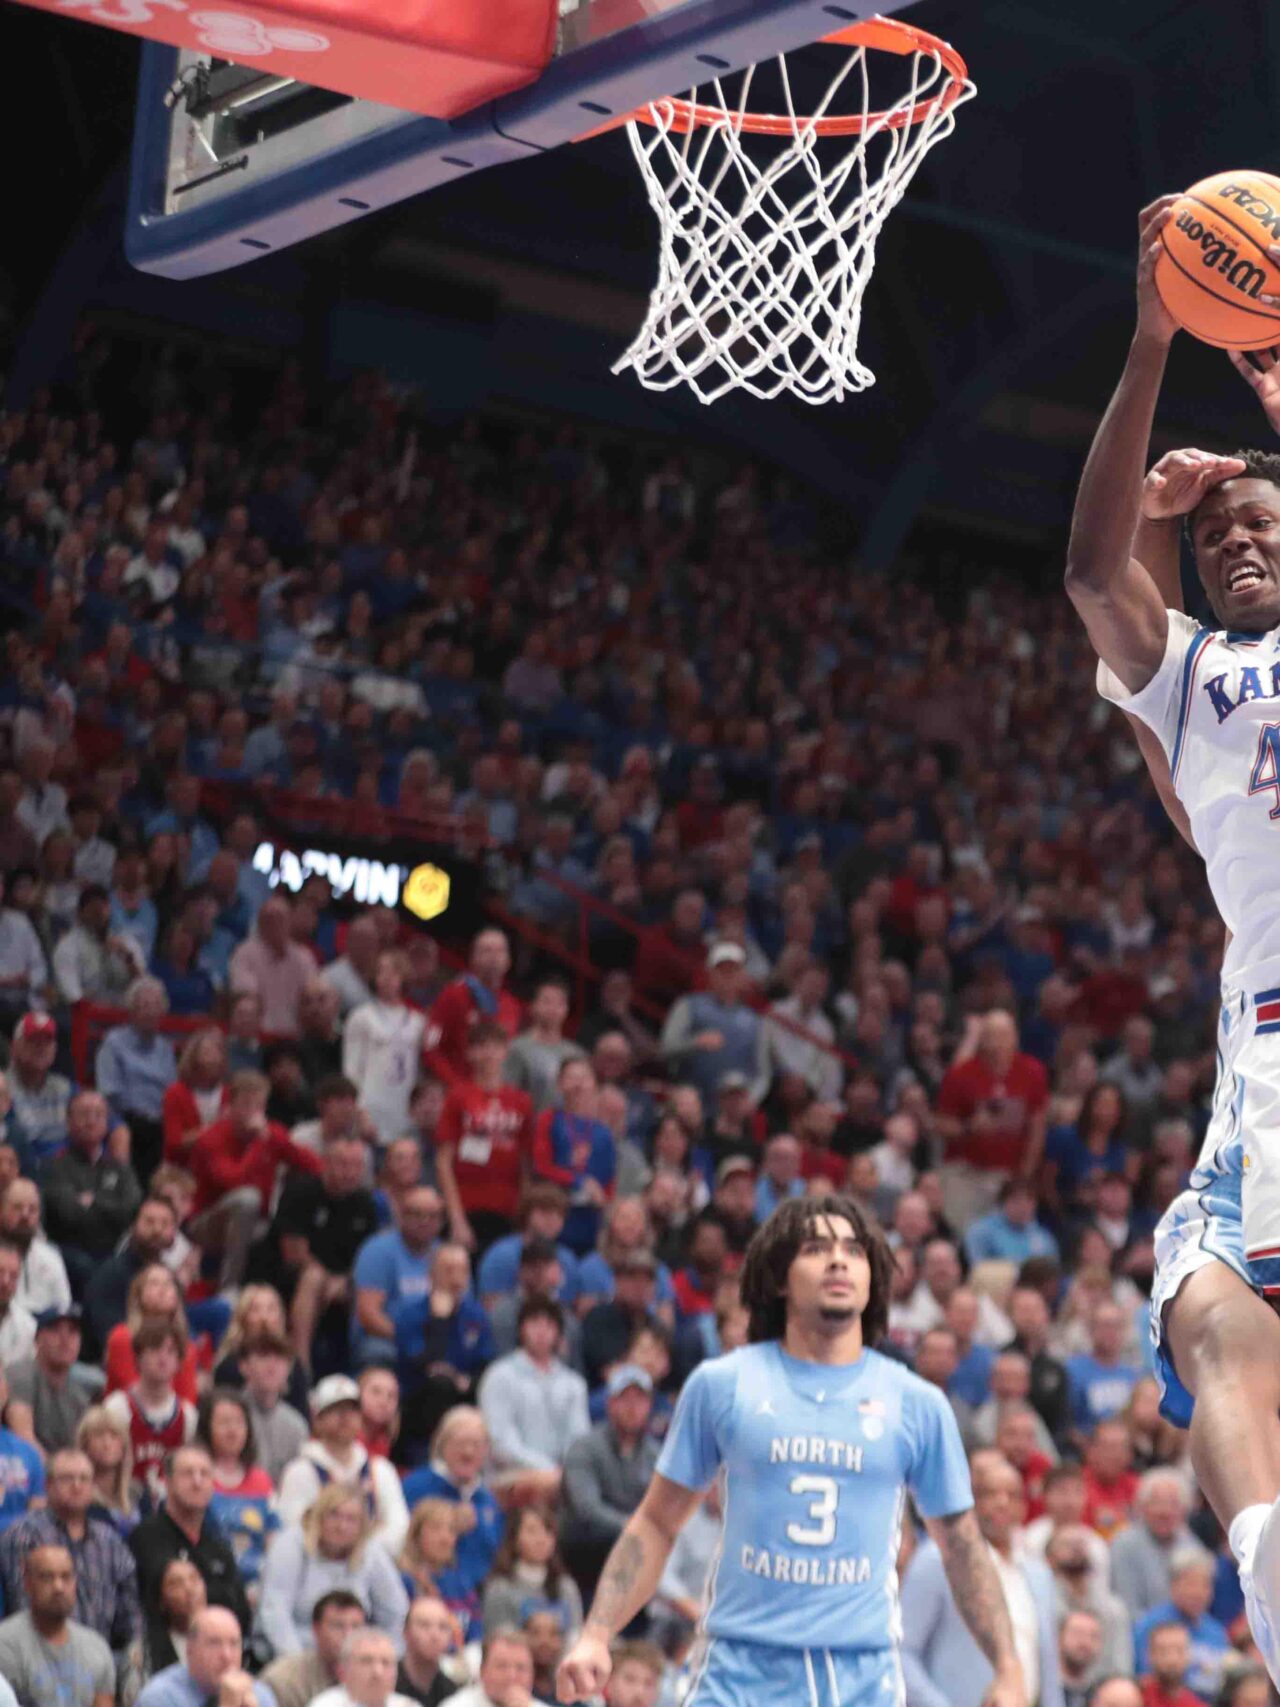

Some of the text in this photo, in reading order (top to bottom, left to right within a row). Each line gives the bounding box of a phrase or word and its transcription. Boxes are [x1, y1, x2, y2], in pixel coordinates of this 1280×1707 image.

[1175, 209, 1267, 300] Wilson
[770, 1436, 864, 1473] NORTH
[787, 1475, 838, 1545] 3
[740, 1544, 872, 1586] CAROLINA
